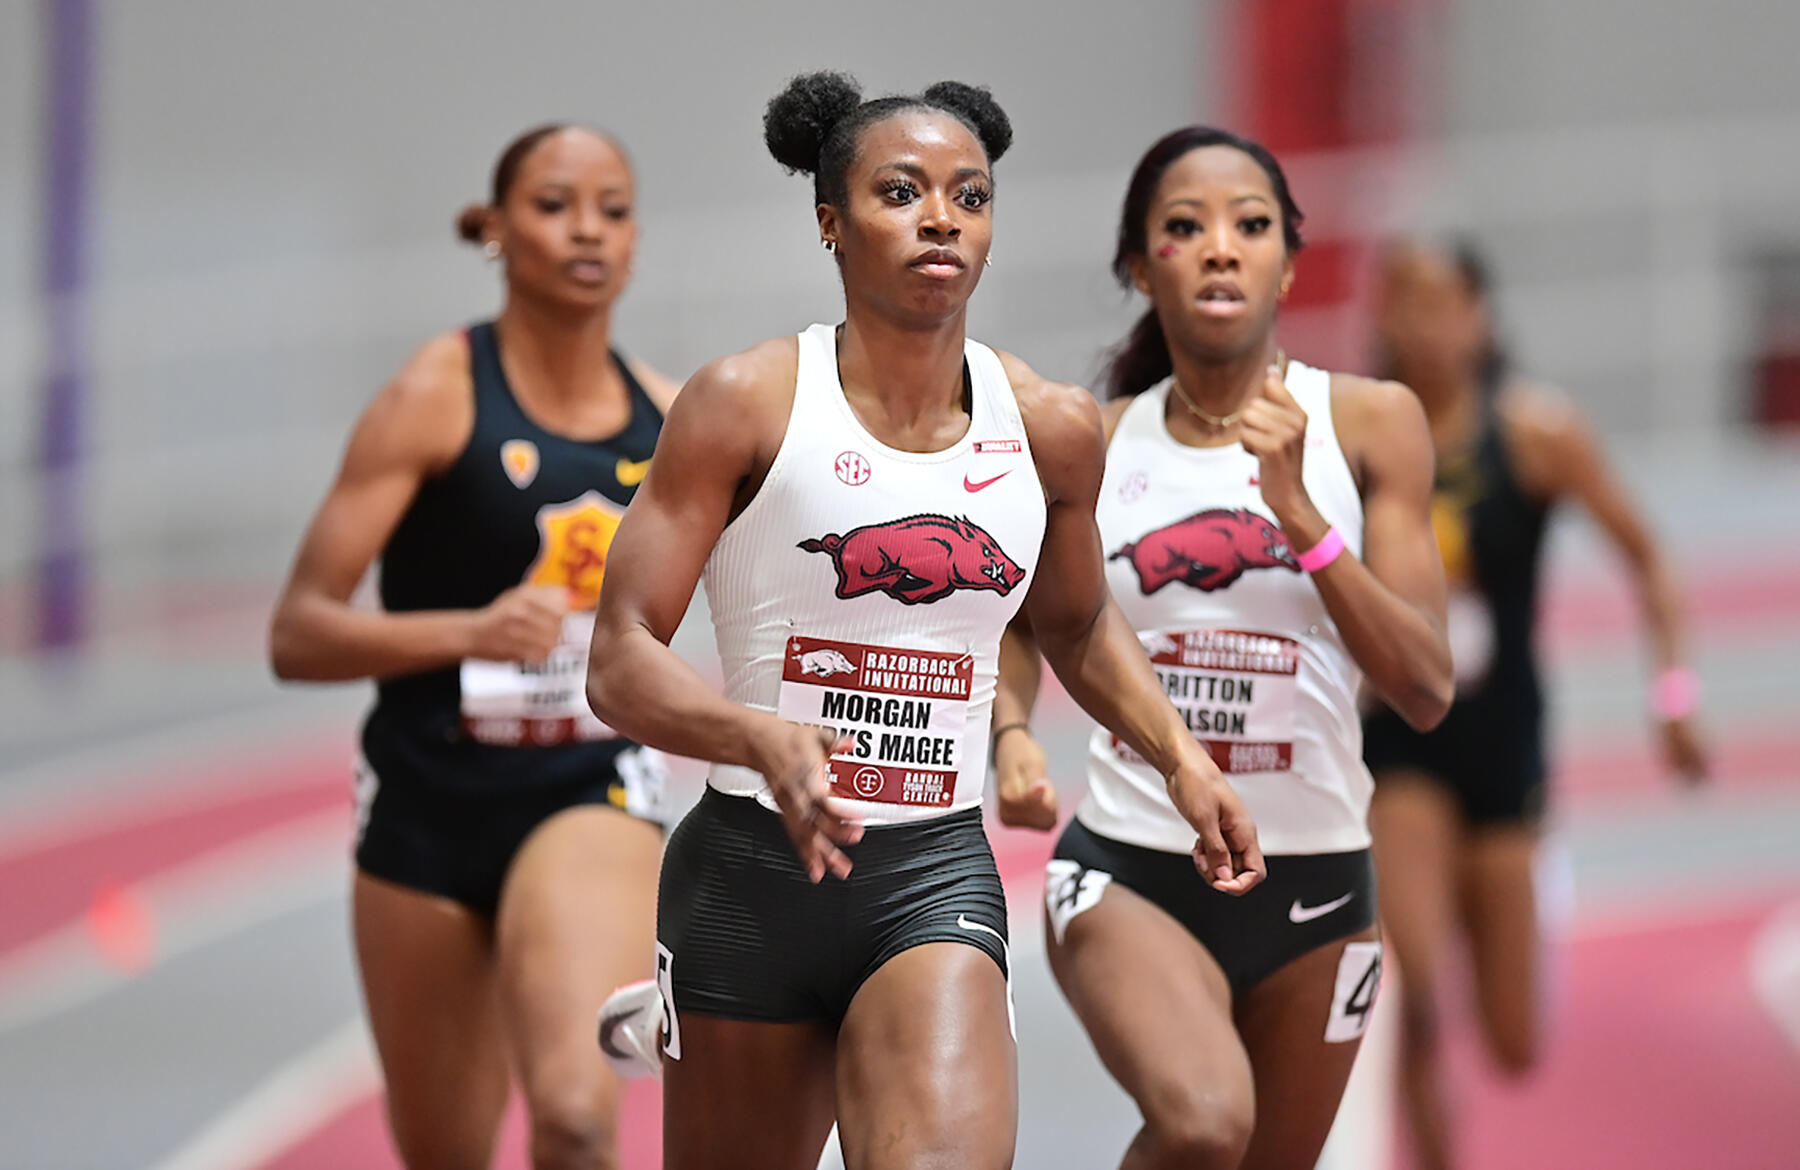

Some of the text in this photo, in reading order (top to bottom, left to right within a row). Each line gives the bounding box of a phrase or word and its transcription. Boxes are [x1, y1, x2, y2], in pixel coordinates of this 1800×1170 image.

[866, 652, 957, 677] RAZORBACK
[864, 670, 968, 696] INVITATIONAL
[1157, 671, 1253, 702] RITTON
[821, 691, 932, 730] MORGAN
[878, 733, 955, 766] MAGEE
[1344, 950, 1381, 1028] 4
